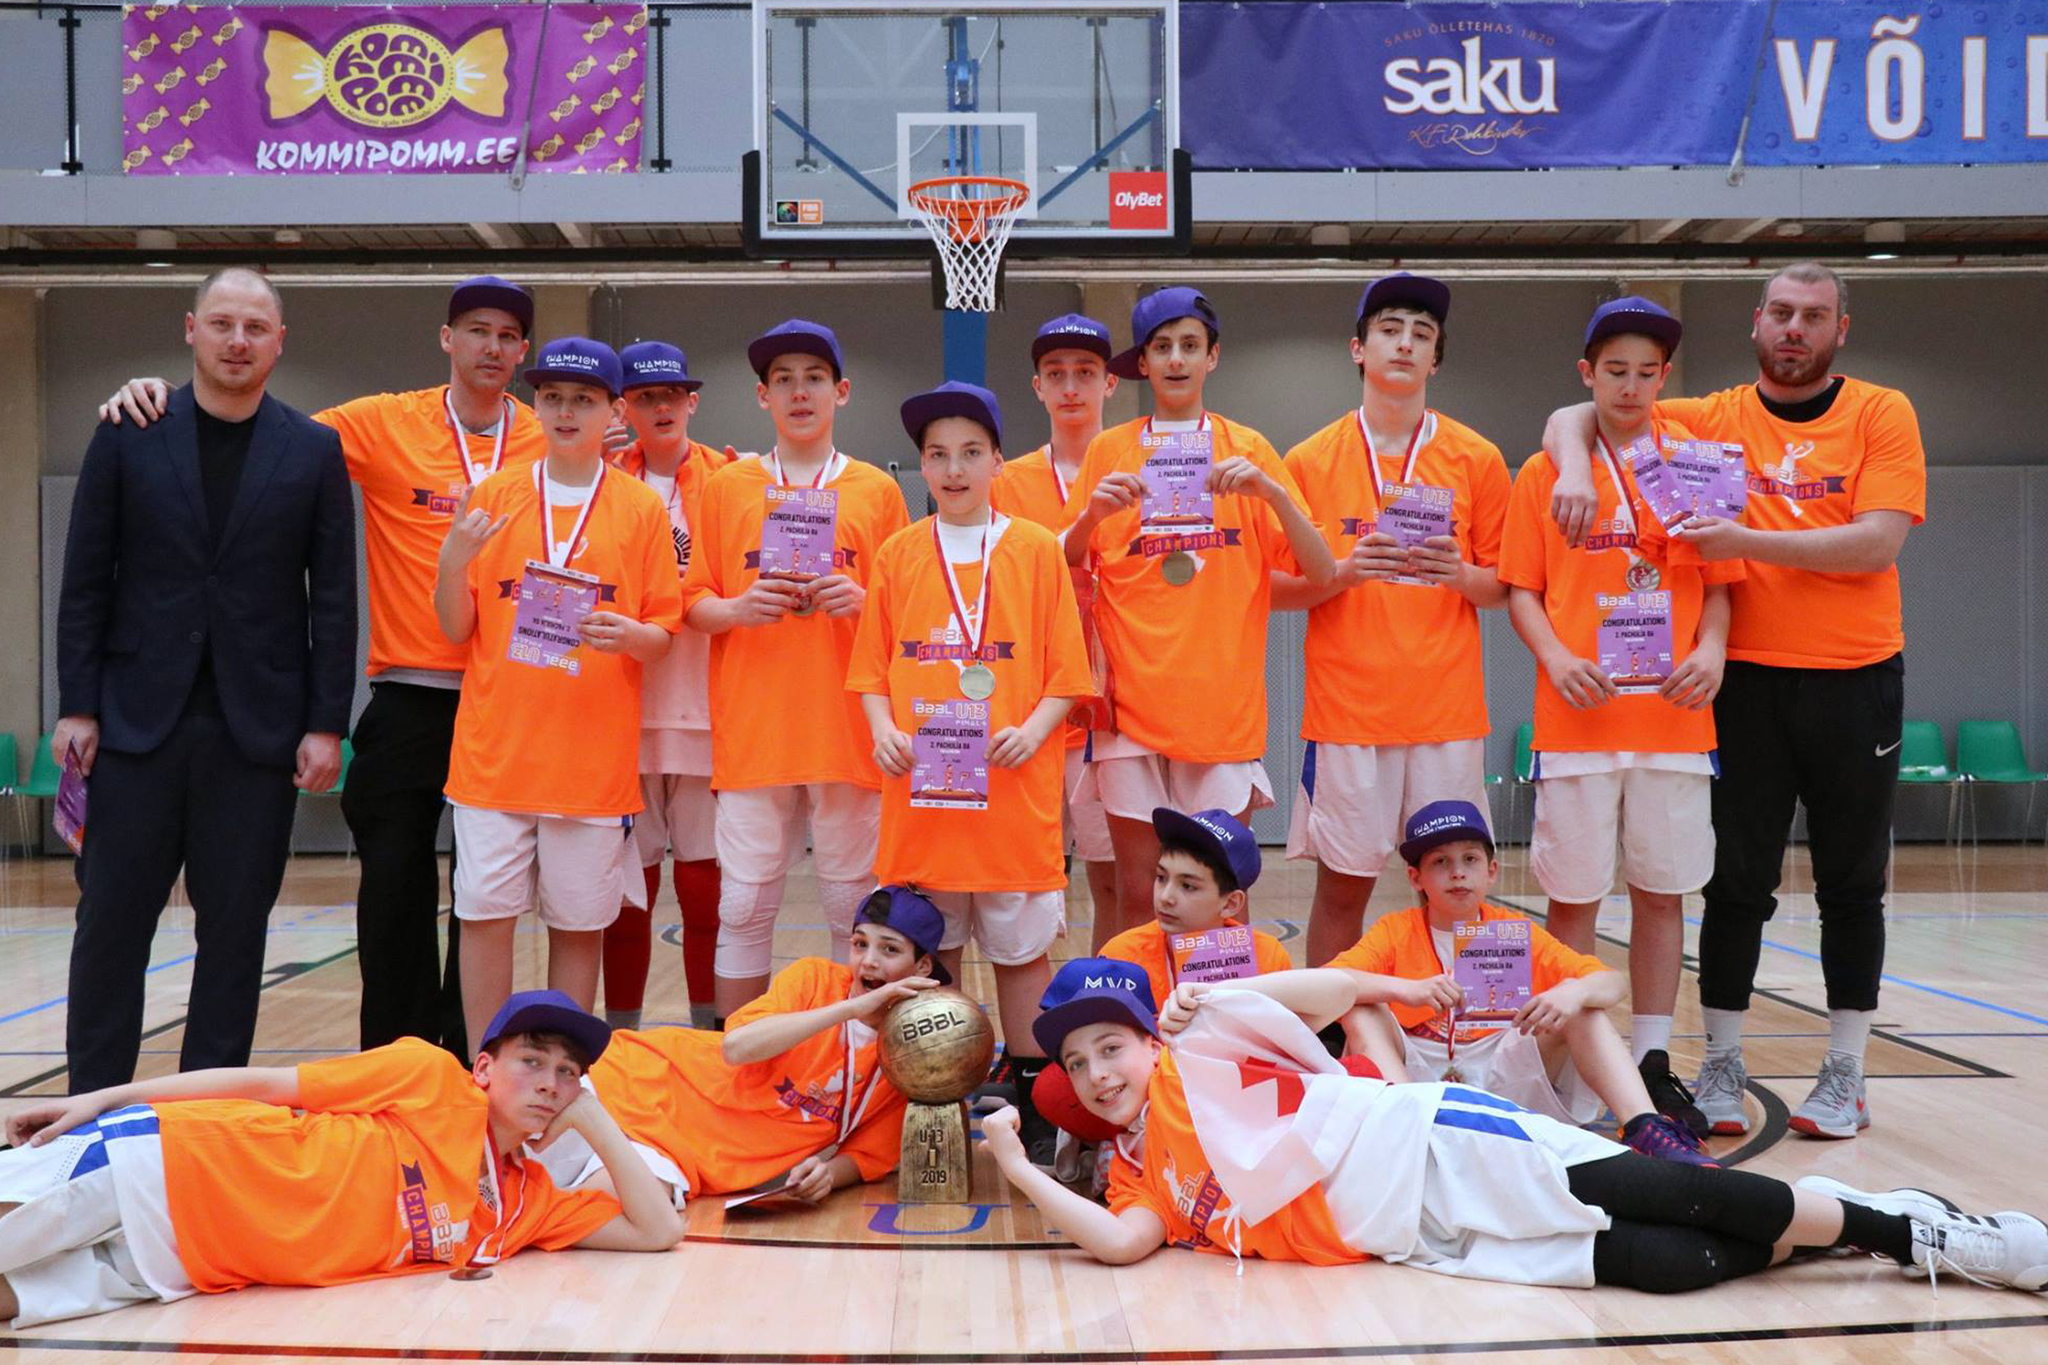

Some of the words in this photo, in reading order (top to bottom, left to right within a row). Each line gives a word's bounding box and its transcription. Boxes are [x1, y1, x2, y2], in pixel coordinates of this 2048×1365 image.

[1384, 28, 1423, 47] SAKU
[1382, 35, 1560, 114] saku
[256, 137, 517, 171] KOMMIPOMM.EE
[1115, 191, 1163, 210] OlyBet
[1146, 457, 1208, 467] CONGRATULATIONS
[1667, 459, 1721, 475] CONGRATULATIONS
[768, 512, 832, 525] CONGRATULATIONS
[1384, 506, 1446, 523] CONGRATULATIONS
[1144, 533, 1225, 557] CHAMPIONS
[1602, 617, 1666, 628] CONGRATULATIONS
[917, 727, 984, 738] CONGRATULATIONS
[1460, 948, 1526, 959] CONGRATULATIONS
[1181, 955, 1251, 973] CONGRATULATIONS
[902, 1011, 967, 1042] BBBL
[921, 1170, 947, 1184] 2019
